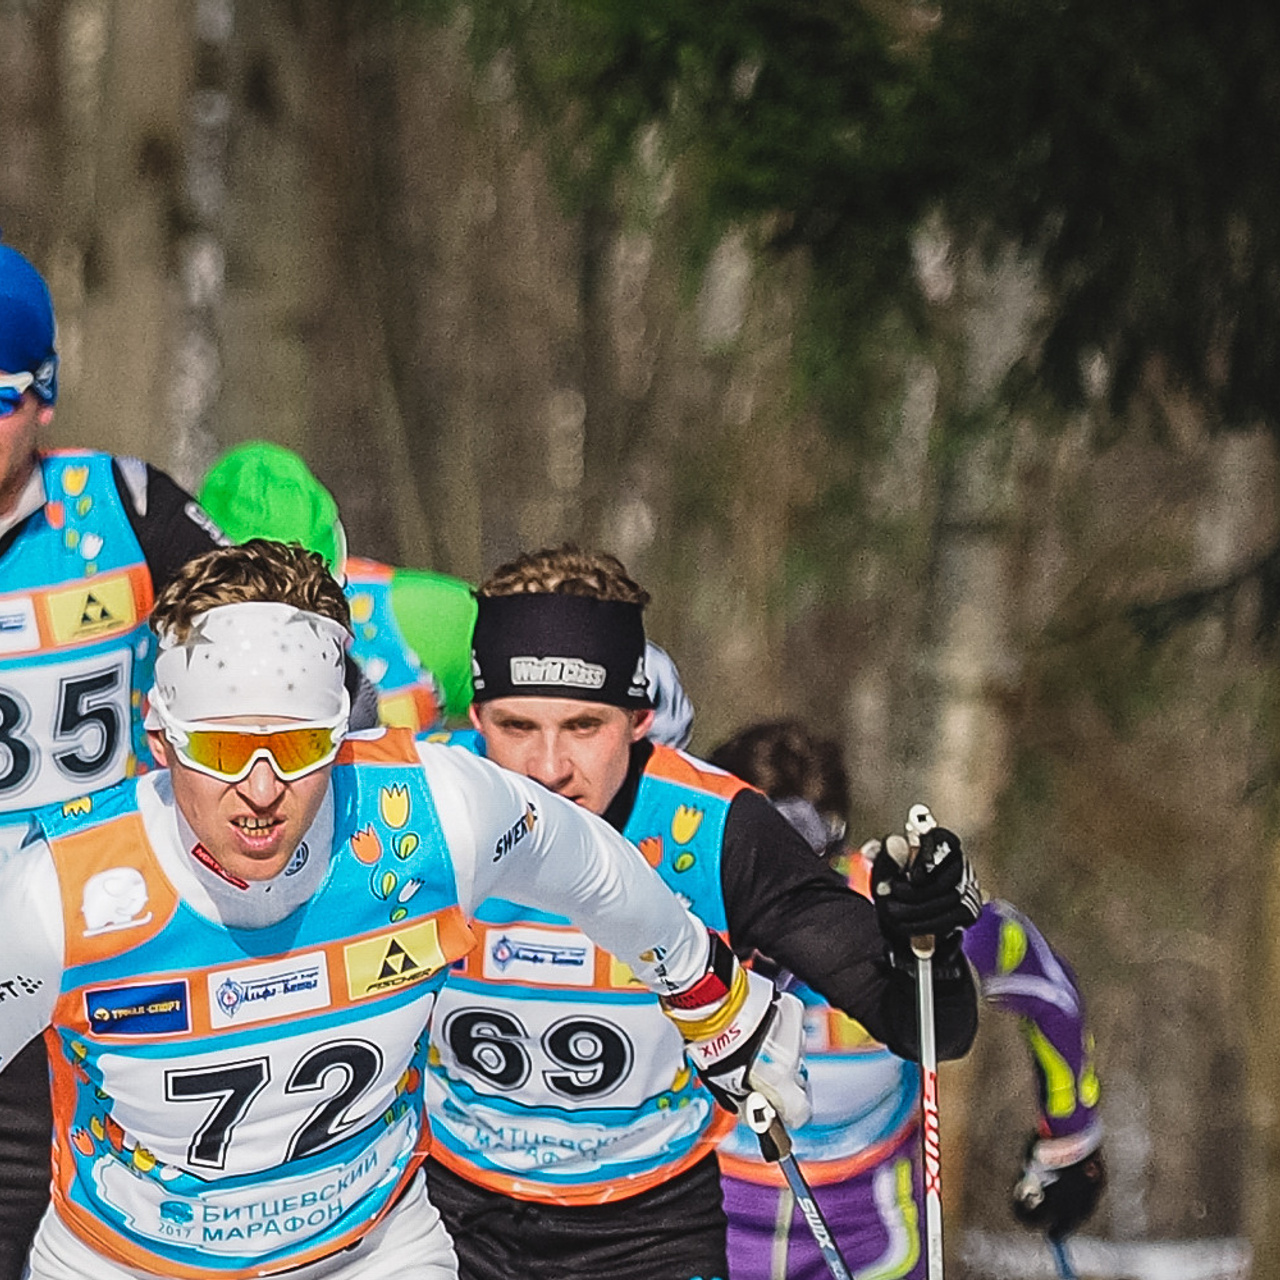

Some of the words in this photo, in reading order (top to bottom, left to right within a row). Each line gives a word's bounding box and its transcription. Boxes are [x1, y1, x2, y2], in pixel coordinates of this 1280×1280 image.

[442, 1006, 635, 1099] 69
[164, 1037, 384, 1170] 72
[157, 1221, 193, 1240] 2017
[201, 1200, 344, 1243] МАРАФОН
[797, 1196, 836, 1251] SWIX
